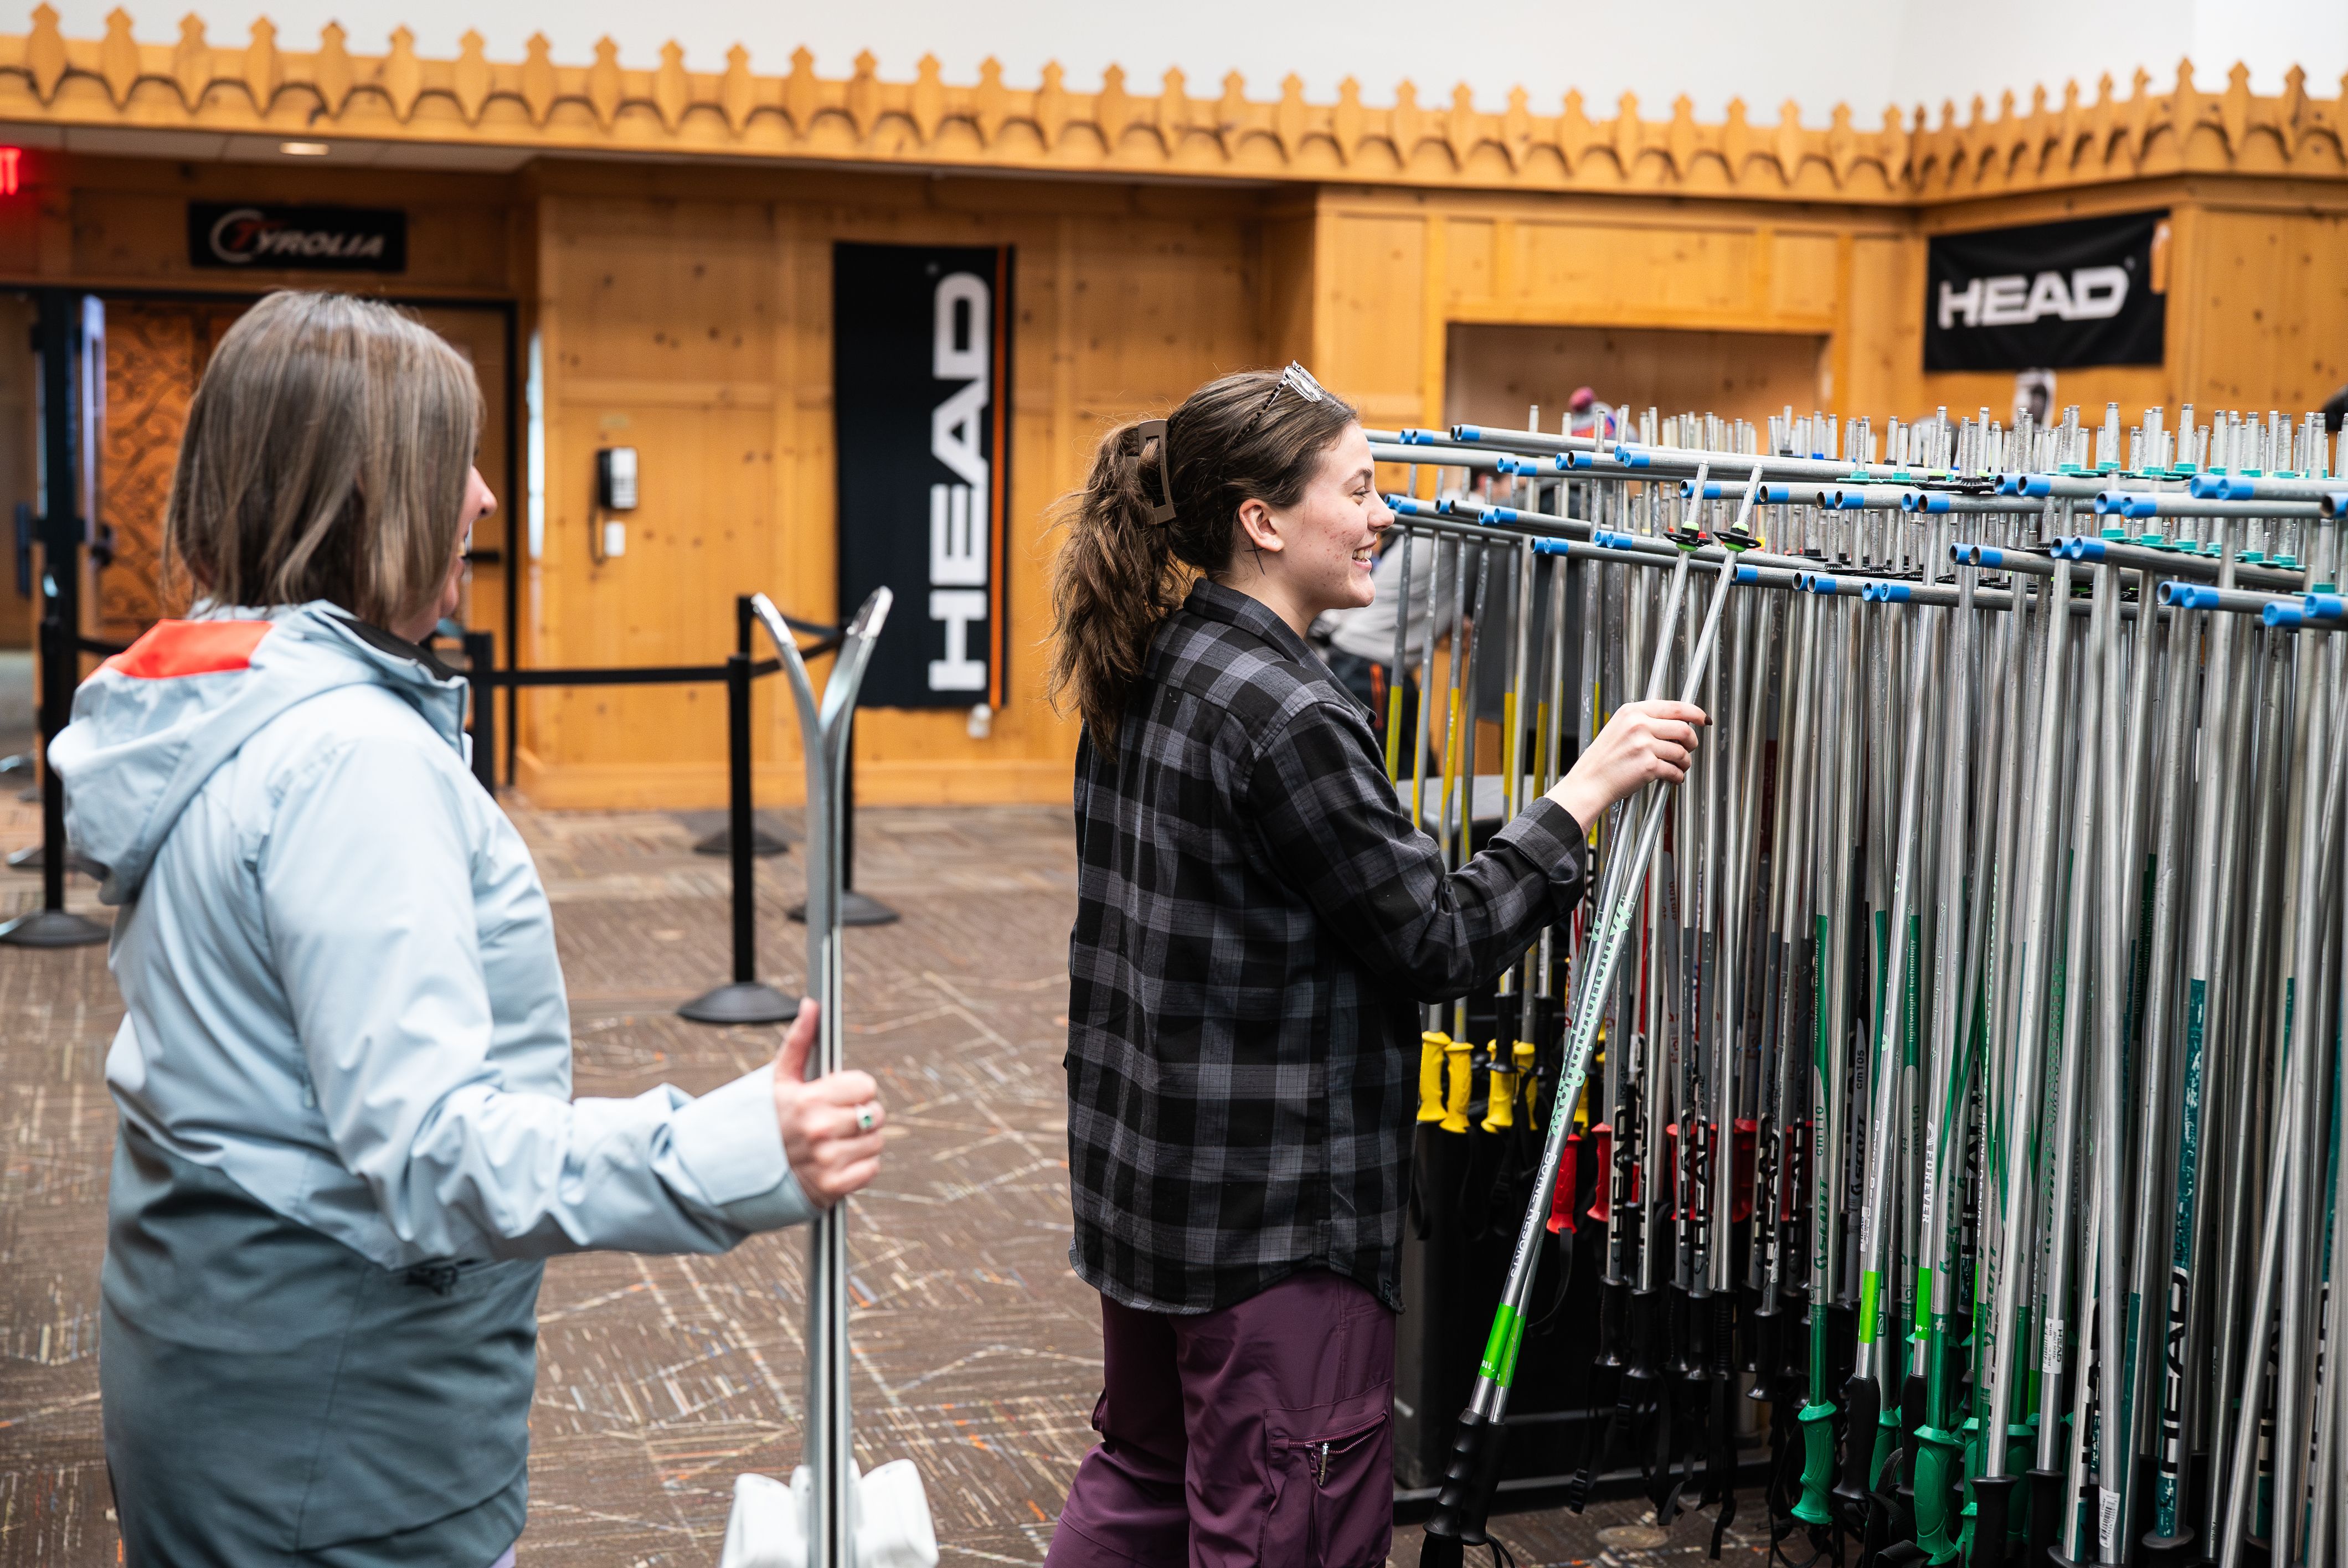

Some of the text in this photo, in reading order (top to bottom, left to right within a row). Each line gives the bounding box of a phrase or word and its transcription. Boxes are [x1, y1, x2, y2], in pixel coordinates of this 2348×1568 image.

[216, 212, 385, 261] TYROLIA
[1937, 265, 2130, 330] HEAD
[928, 272, 991, 692] HEAD
[1815, 1106, 1824, 1157] cm110
[1695, 1116, 1709, 1251] HEAD
[1817, 1176, 1829, 1253] SCOTT
[1922, 1150, 1934, 1223] FOREVER
[2160, 1272, 2188, 1472] HEAD
